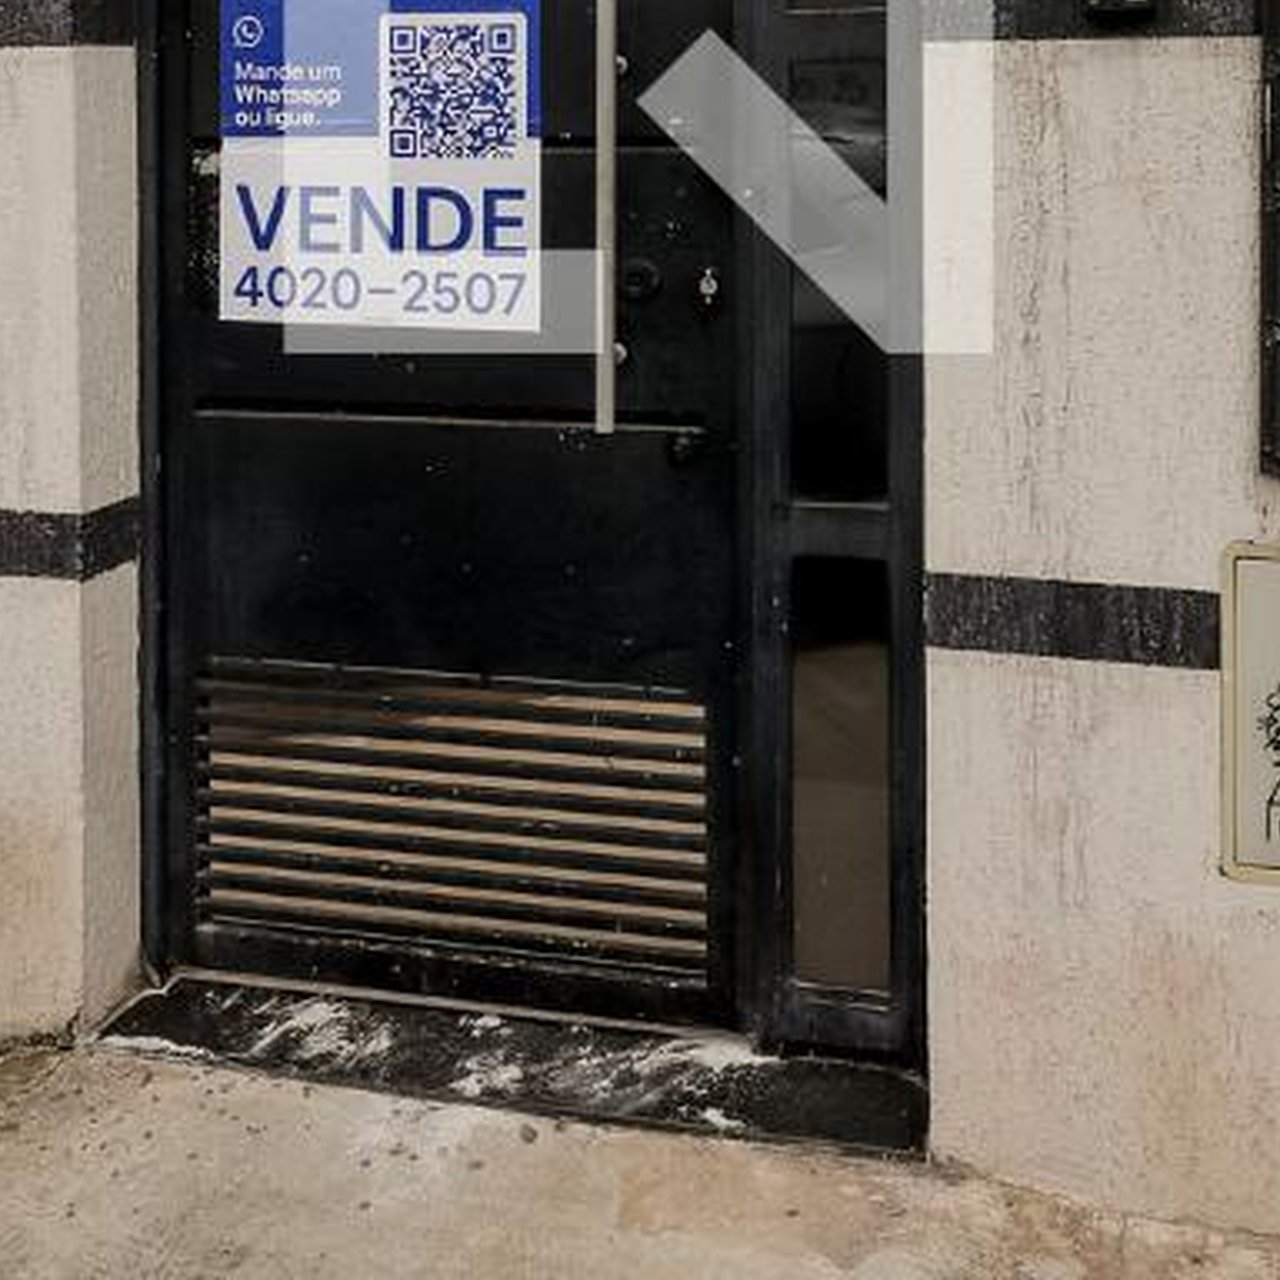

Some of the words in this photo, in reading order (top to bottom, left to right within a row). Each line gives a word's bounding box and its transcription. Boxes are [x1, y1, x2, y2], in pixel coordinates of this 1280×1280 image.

[234, 60, 306, 81] Mande
[308, 65, 342, 81] um
[234, 111, 261, 128] ou
[235, 184, 528, 258] VENDE
[233, 265, 528, 316] 4020-2507
